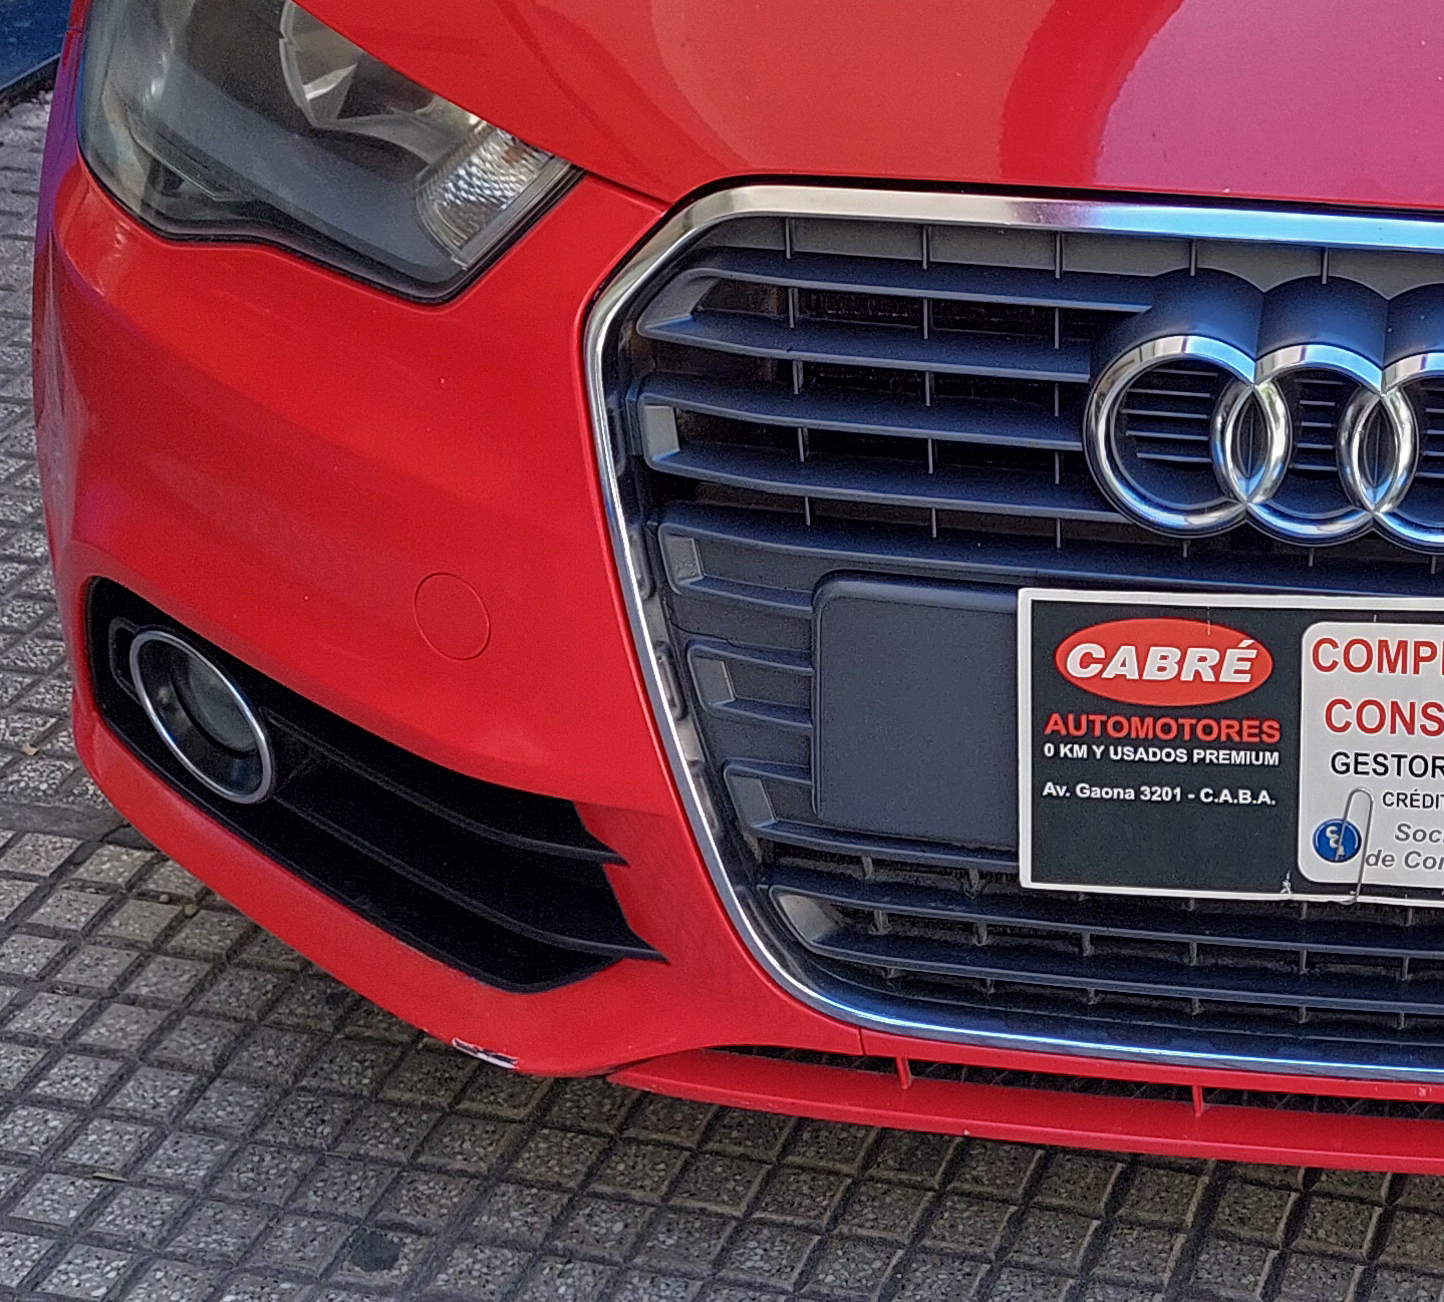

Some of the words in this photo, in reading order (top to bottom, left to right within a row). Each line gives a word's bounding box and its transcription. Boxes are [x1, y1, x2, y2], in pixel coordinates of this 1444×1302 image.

[1065, 639, 1258, 683] CABRÉ
[1043, 712, 1281, 743] AUTOMOTORES
[1043, 743, 1055, 758] 0
[1060, 743, 1088, 759] KM
[1091, 744, 1105, 760] Y
[1109, 745, 1188, 763] USADOS
[1192, 749, 1280, 766] PREMIUM
[1042, 781, 1071, 797] Av.
[1075, 782, 1136, 800] Gaona
[1139, 785, 1182, 802] 3201
[1199, 788, 1277, 805] C.A.B.A.
[1364, 847, 1397, 869] de
